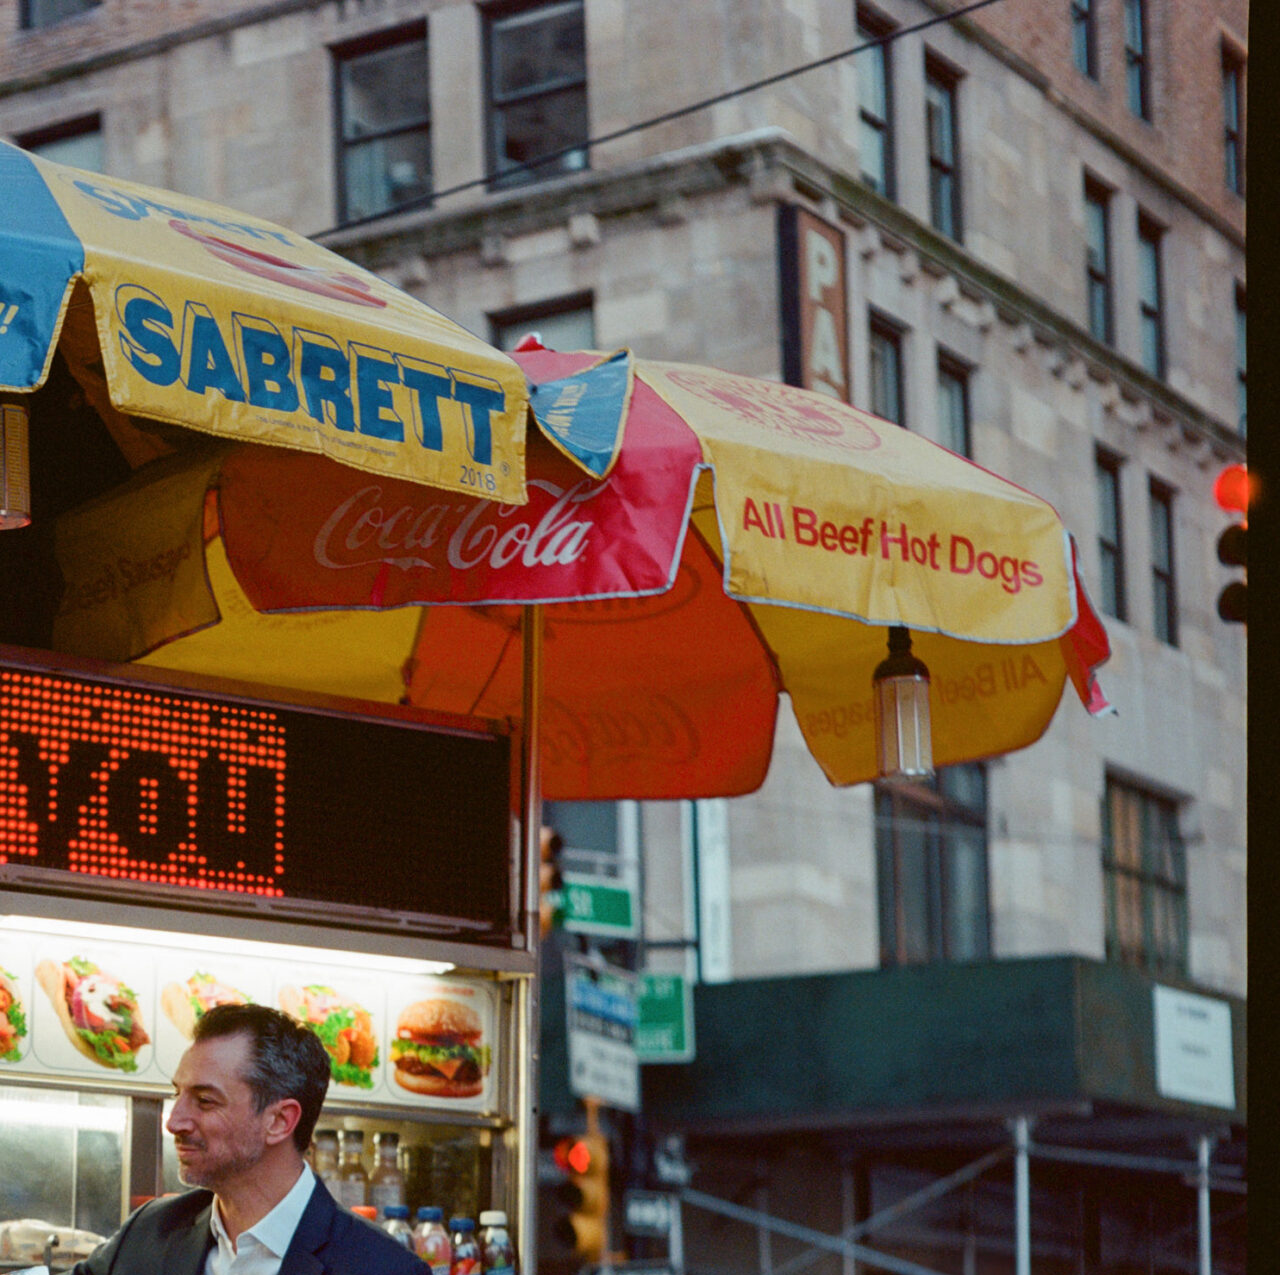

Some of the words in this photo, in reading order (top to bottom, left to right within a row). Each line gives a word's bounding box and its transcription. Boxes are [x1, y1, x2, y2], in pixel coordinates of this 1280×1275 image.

[116, 284, 506, 466] SABRETT
[459, 465, 497, 492] 2018
[742, 497, 787, 540] All
[795, 506, 876, 558] Beef
[879, 519, 943, 573] Hot
[948, 534, 1045, 595] Dogs
